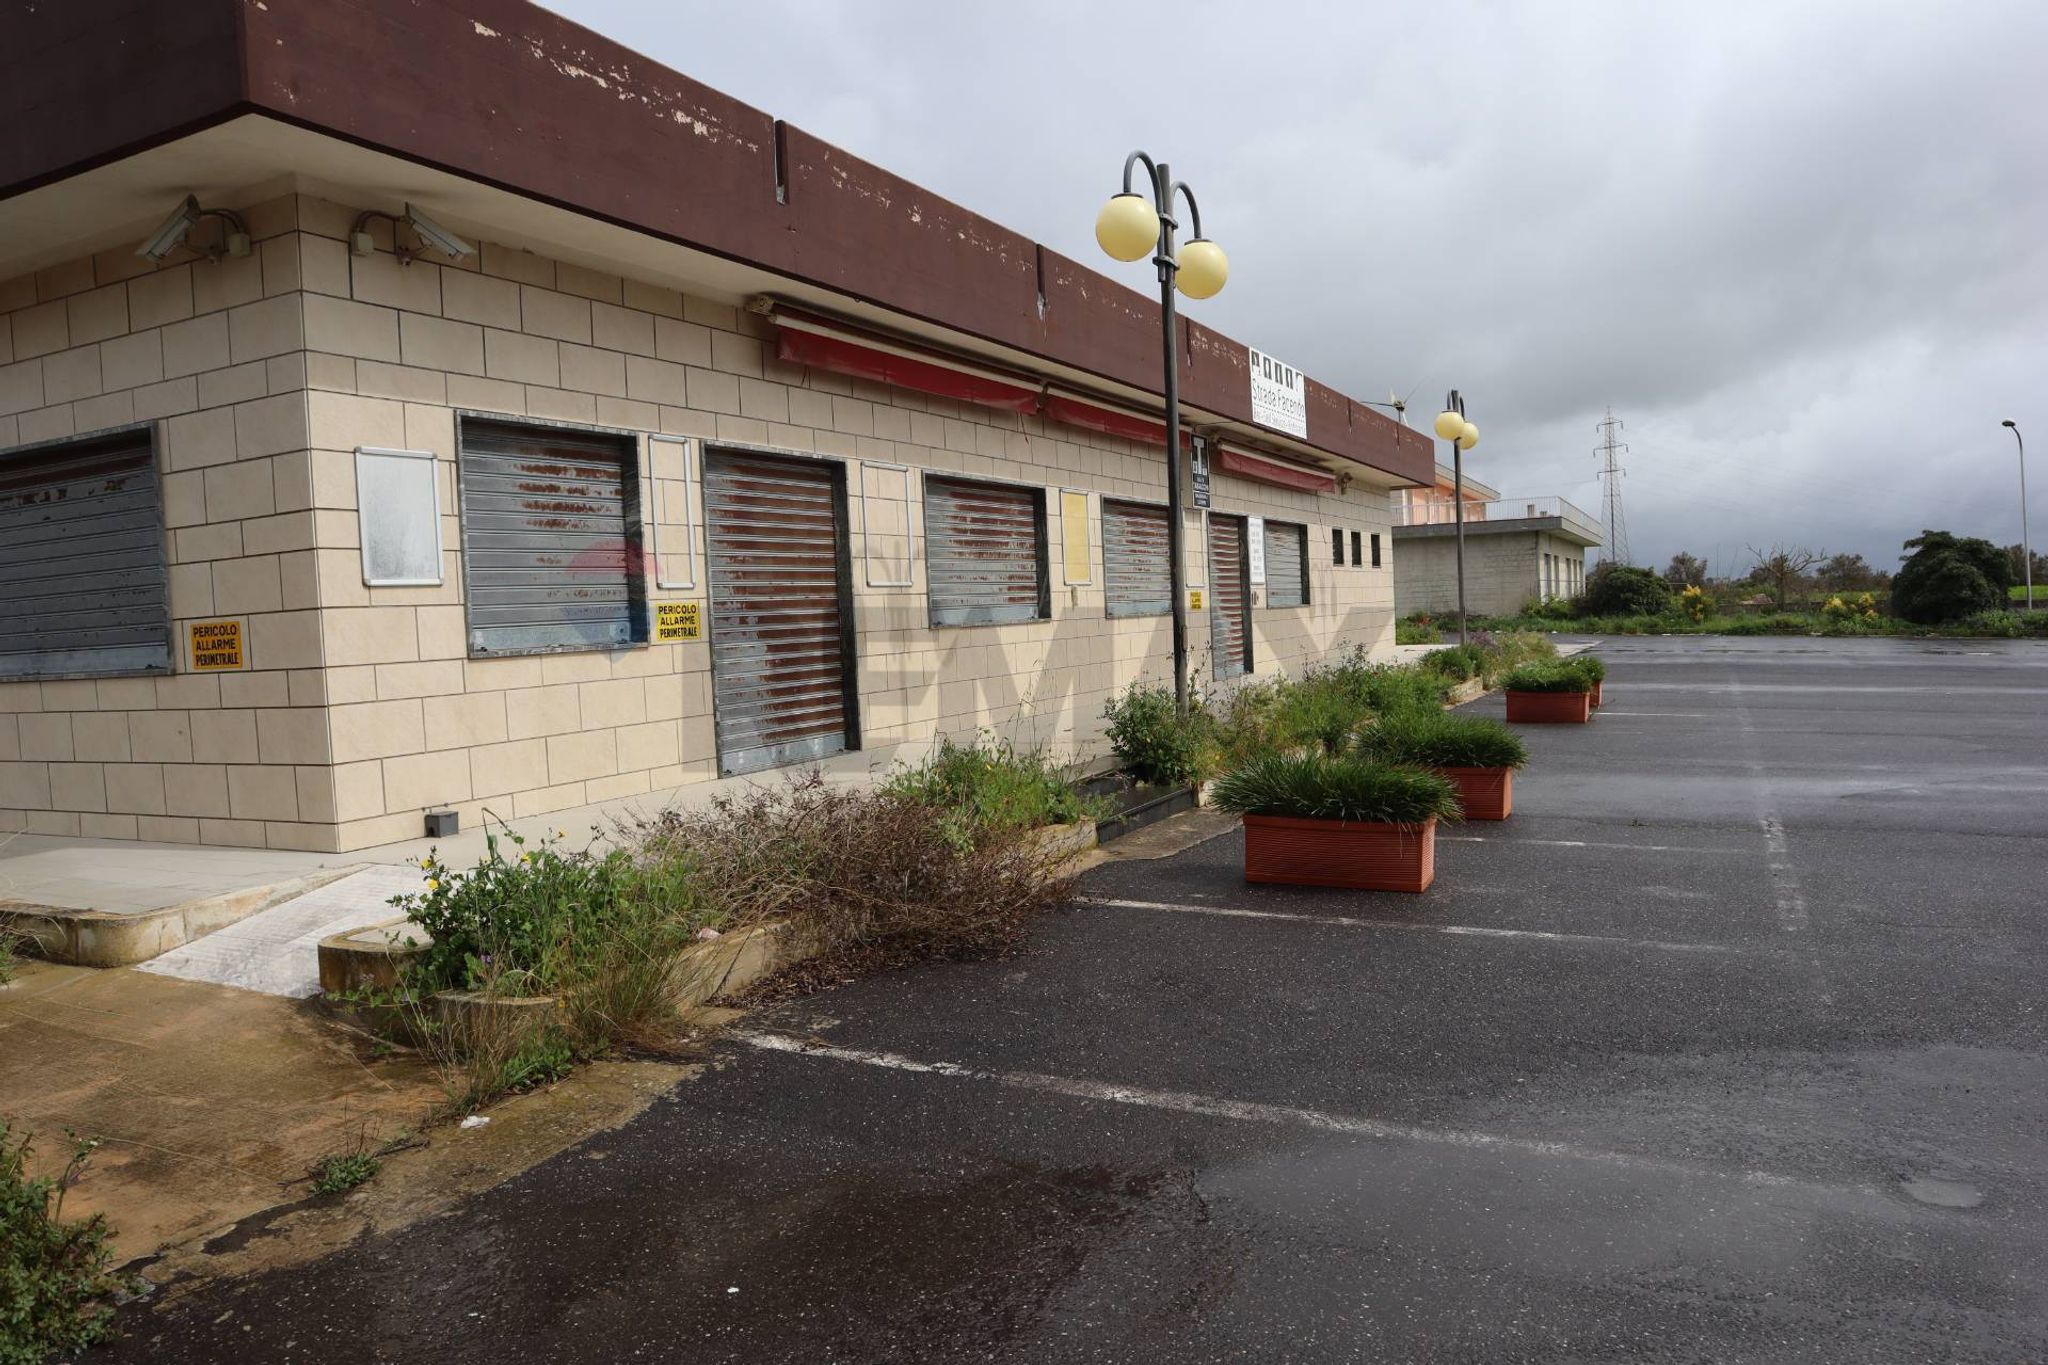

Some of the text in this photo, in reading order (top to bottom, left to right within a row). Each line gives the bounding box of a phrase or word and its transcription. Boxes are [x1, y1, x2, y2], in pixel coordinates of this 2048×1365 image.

[658, 604, 697, 615] PERICOLO
[660, 616, 696, 626] ALLARME
[193, 624, 237, 638] PERICOLO
[659, 627, 698, 639] PERIMETRALE
[196, 638, 236, 652] ALLARME
[195, 652, 239, 667] PERIMETRALE
